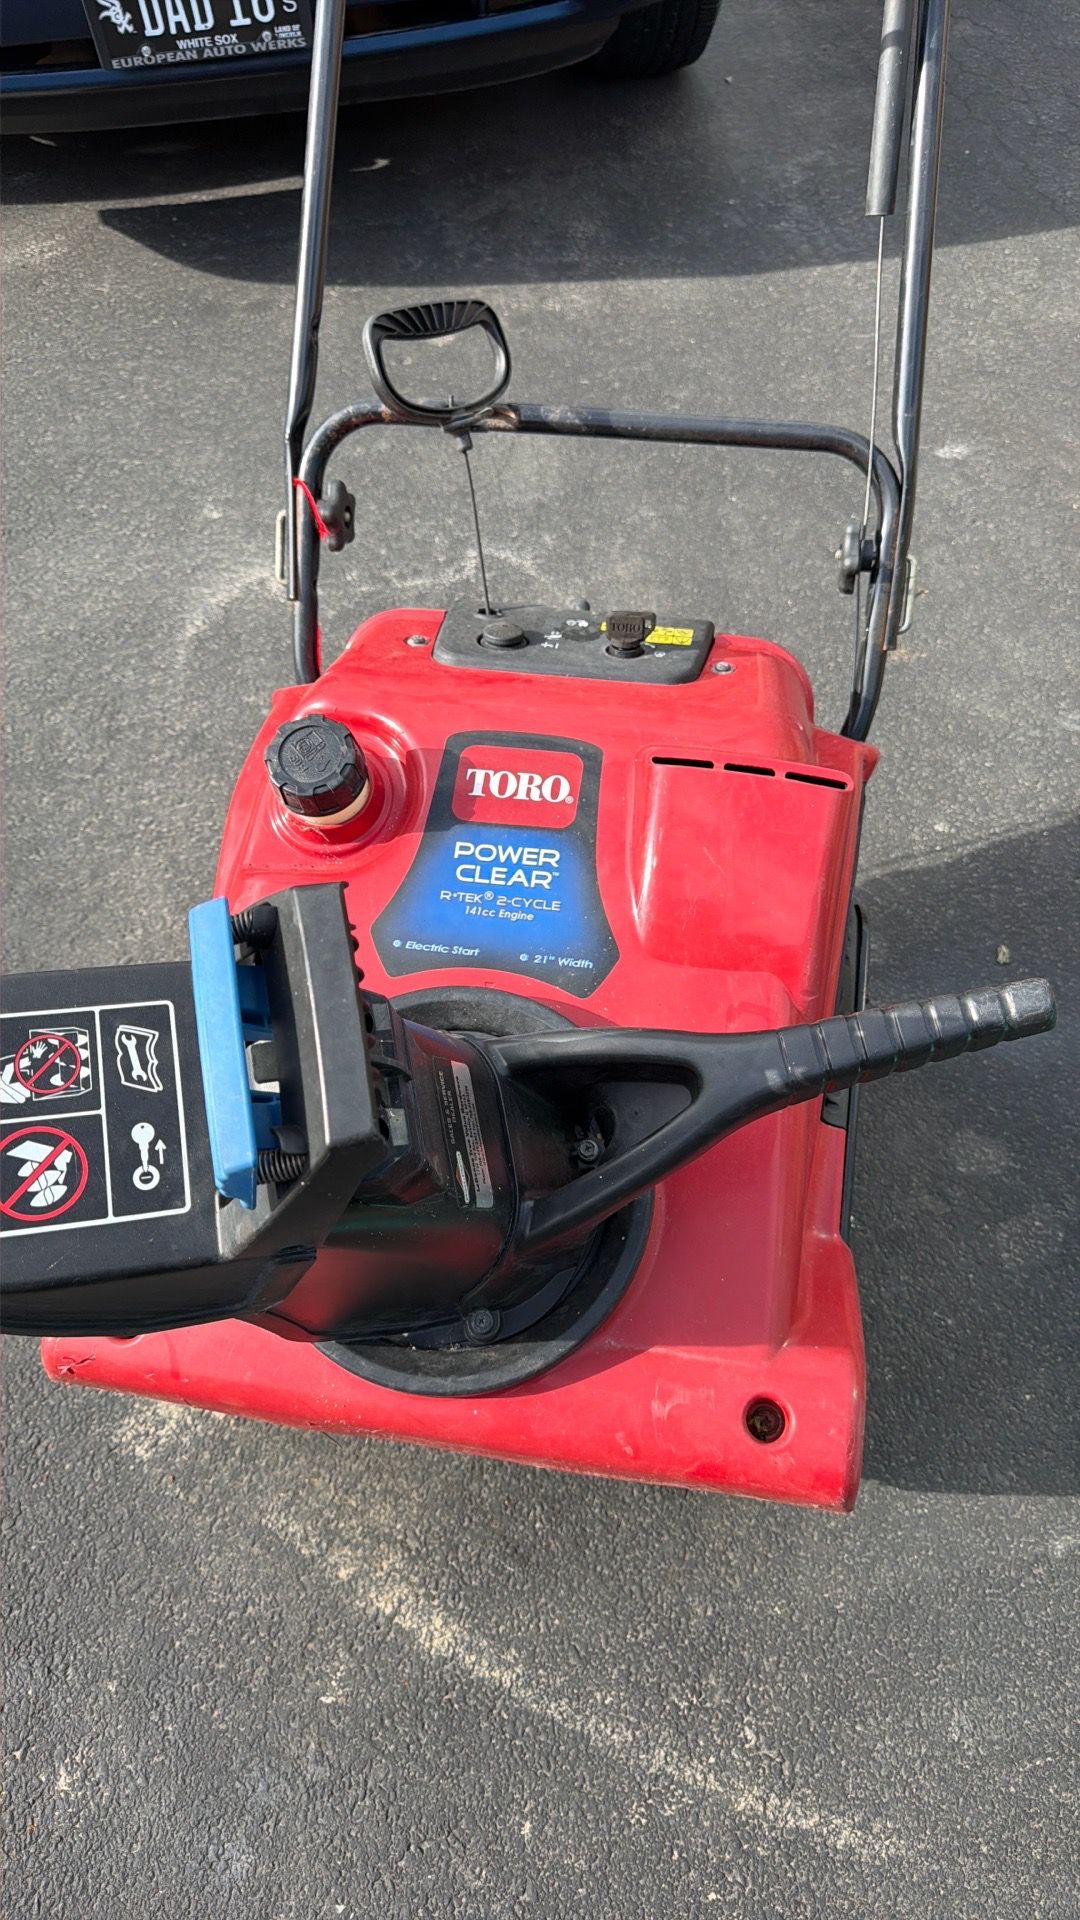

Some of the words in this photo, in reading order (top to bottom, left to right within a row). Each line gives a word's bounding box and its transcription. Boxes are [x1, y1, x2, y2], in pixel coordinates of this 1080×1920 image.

[138, 0, 215, 37] DAD
[176, 36, 212, 50] WHITE
[214, 33, 239, 46] SOX
[111, 49, 198, 69] EUROPEAN
[203, 43, 247, 58] AUTO
[249, 37, 307, 53] WERKS
[611, 622, 641, 633] TORO
[453, 841, 561, 868] POWER
[496, 895, 561, 911] 2-CYCLE
[465, 905, 496, 918] 141cc
[499, 908, 534, 922] Engine
[405, 940, 450, 954] Electric
[453, 945, 480, 957] Start
[558, 956, 593, 969] Width
[438, 1071, 448, 1106] SERVICE
[447, 1090, 456, 1123] DEALER
